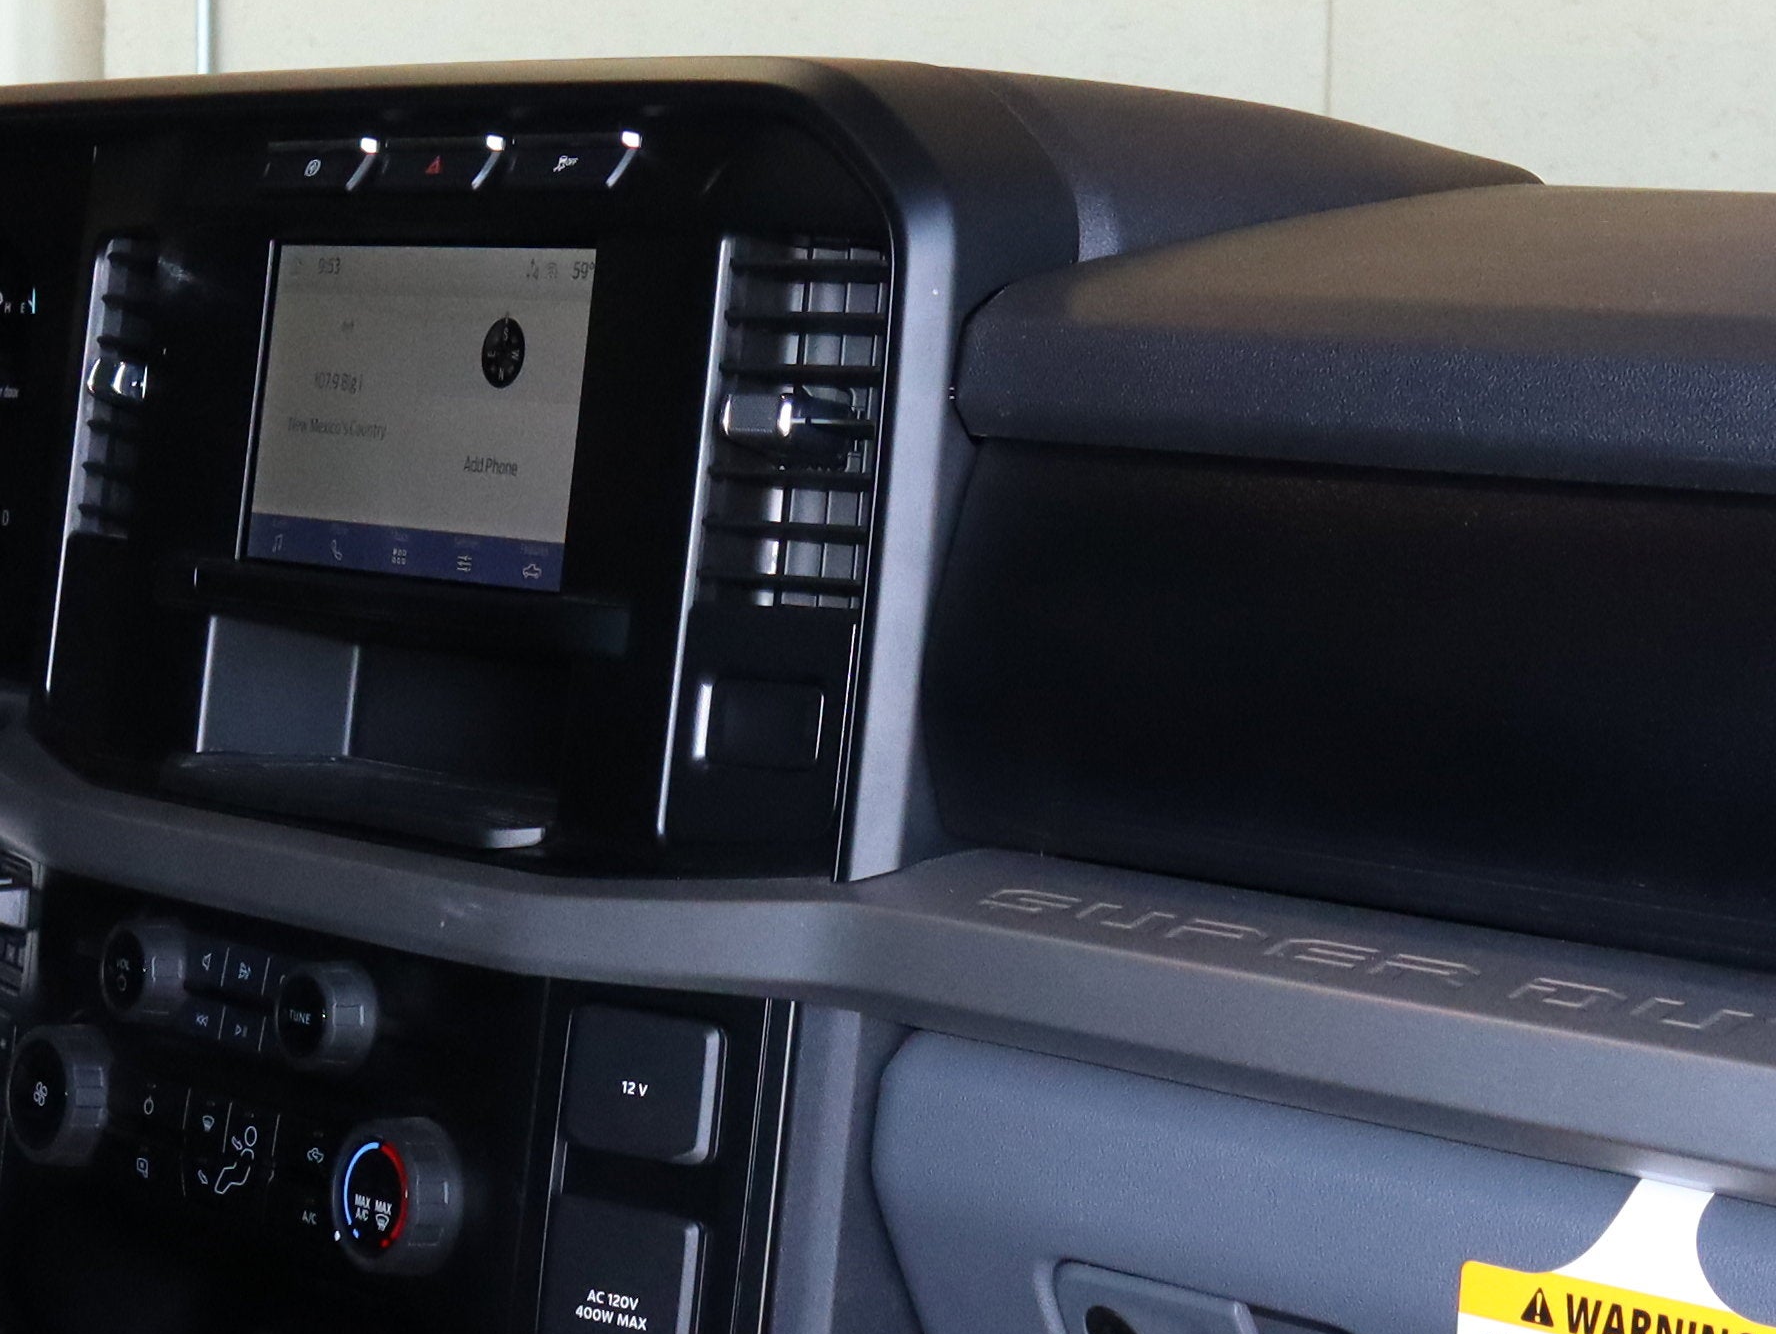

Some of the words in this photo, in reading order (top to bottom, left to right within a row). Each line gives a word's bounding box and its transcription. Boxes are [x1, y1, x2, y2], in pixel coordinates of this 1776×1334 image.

[463, 455, 484, 474] Add
[485, 458, 519, 477] Phone
[977, 886, 1482, 991] SUPER
[288, 1008, 312, 1027] TUNE
[620, 1079, 636, 1096] 12
[637, 1081, 649, 1098] V
[354, 1193, 372, 1210] MAX
[374, 1199, 393, 1216] MAX
[301, 1210, 317, 1225] A/C
[586, 1288, 606, 1307] AC
[606, 1291, 641, 1313] 120V
[574, 1304, 615, 1328] 400W
[616, 1312, 648, 1333] MAX
